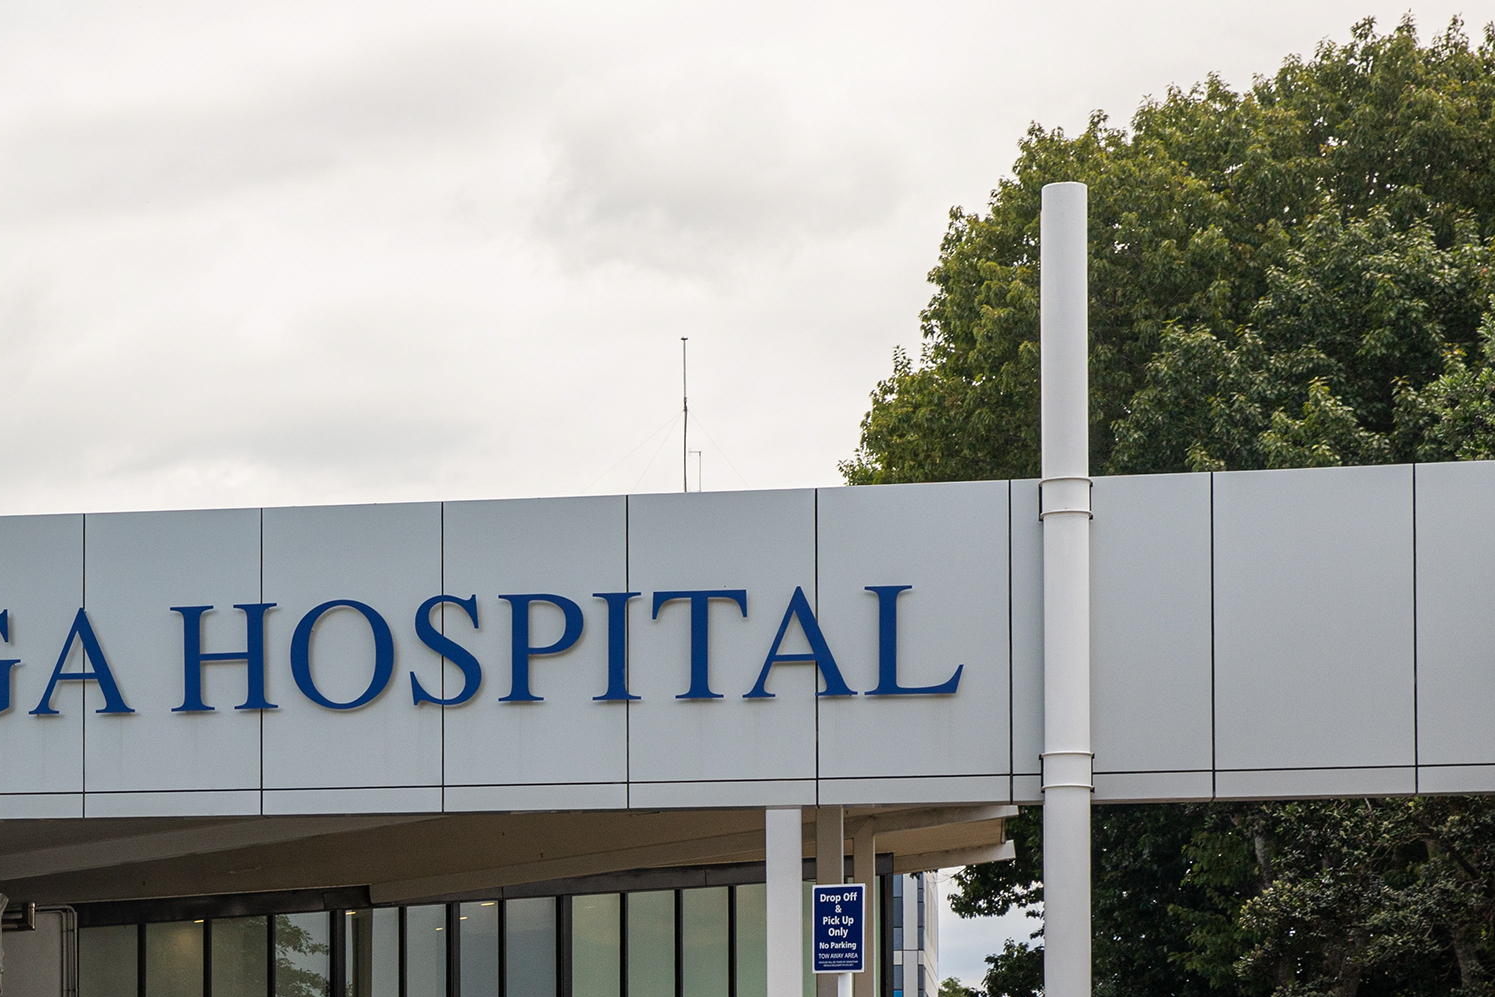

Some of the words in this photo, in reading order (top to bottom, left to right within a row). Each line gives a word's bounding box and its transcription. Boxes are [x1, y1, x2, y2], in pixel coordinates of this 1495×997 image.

[172, 585, 963, 712] HOSPITAL
[820, 893, 842, 904] Drop
[843, 892, 857, 901] Off
[835, 904, 842, 913] &
[822, 916, 840, 925] Pick
[842, 916, 854, 926] Up
[828, 927, 848, 938] Only
[830, 941, 857, 950] Parking
